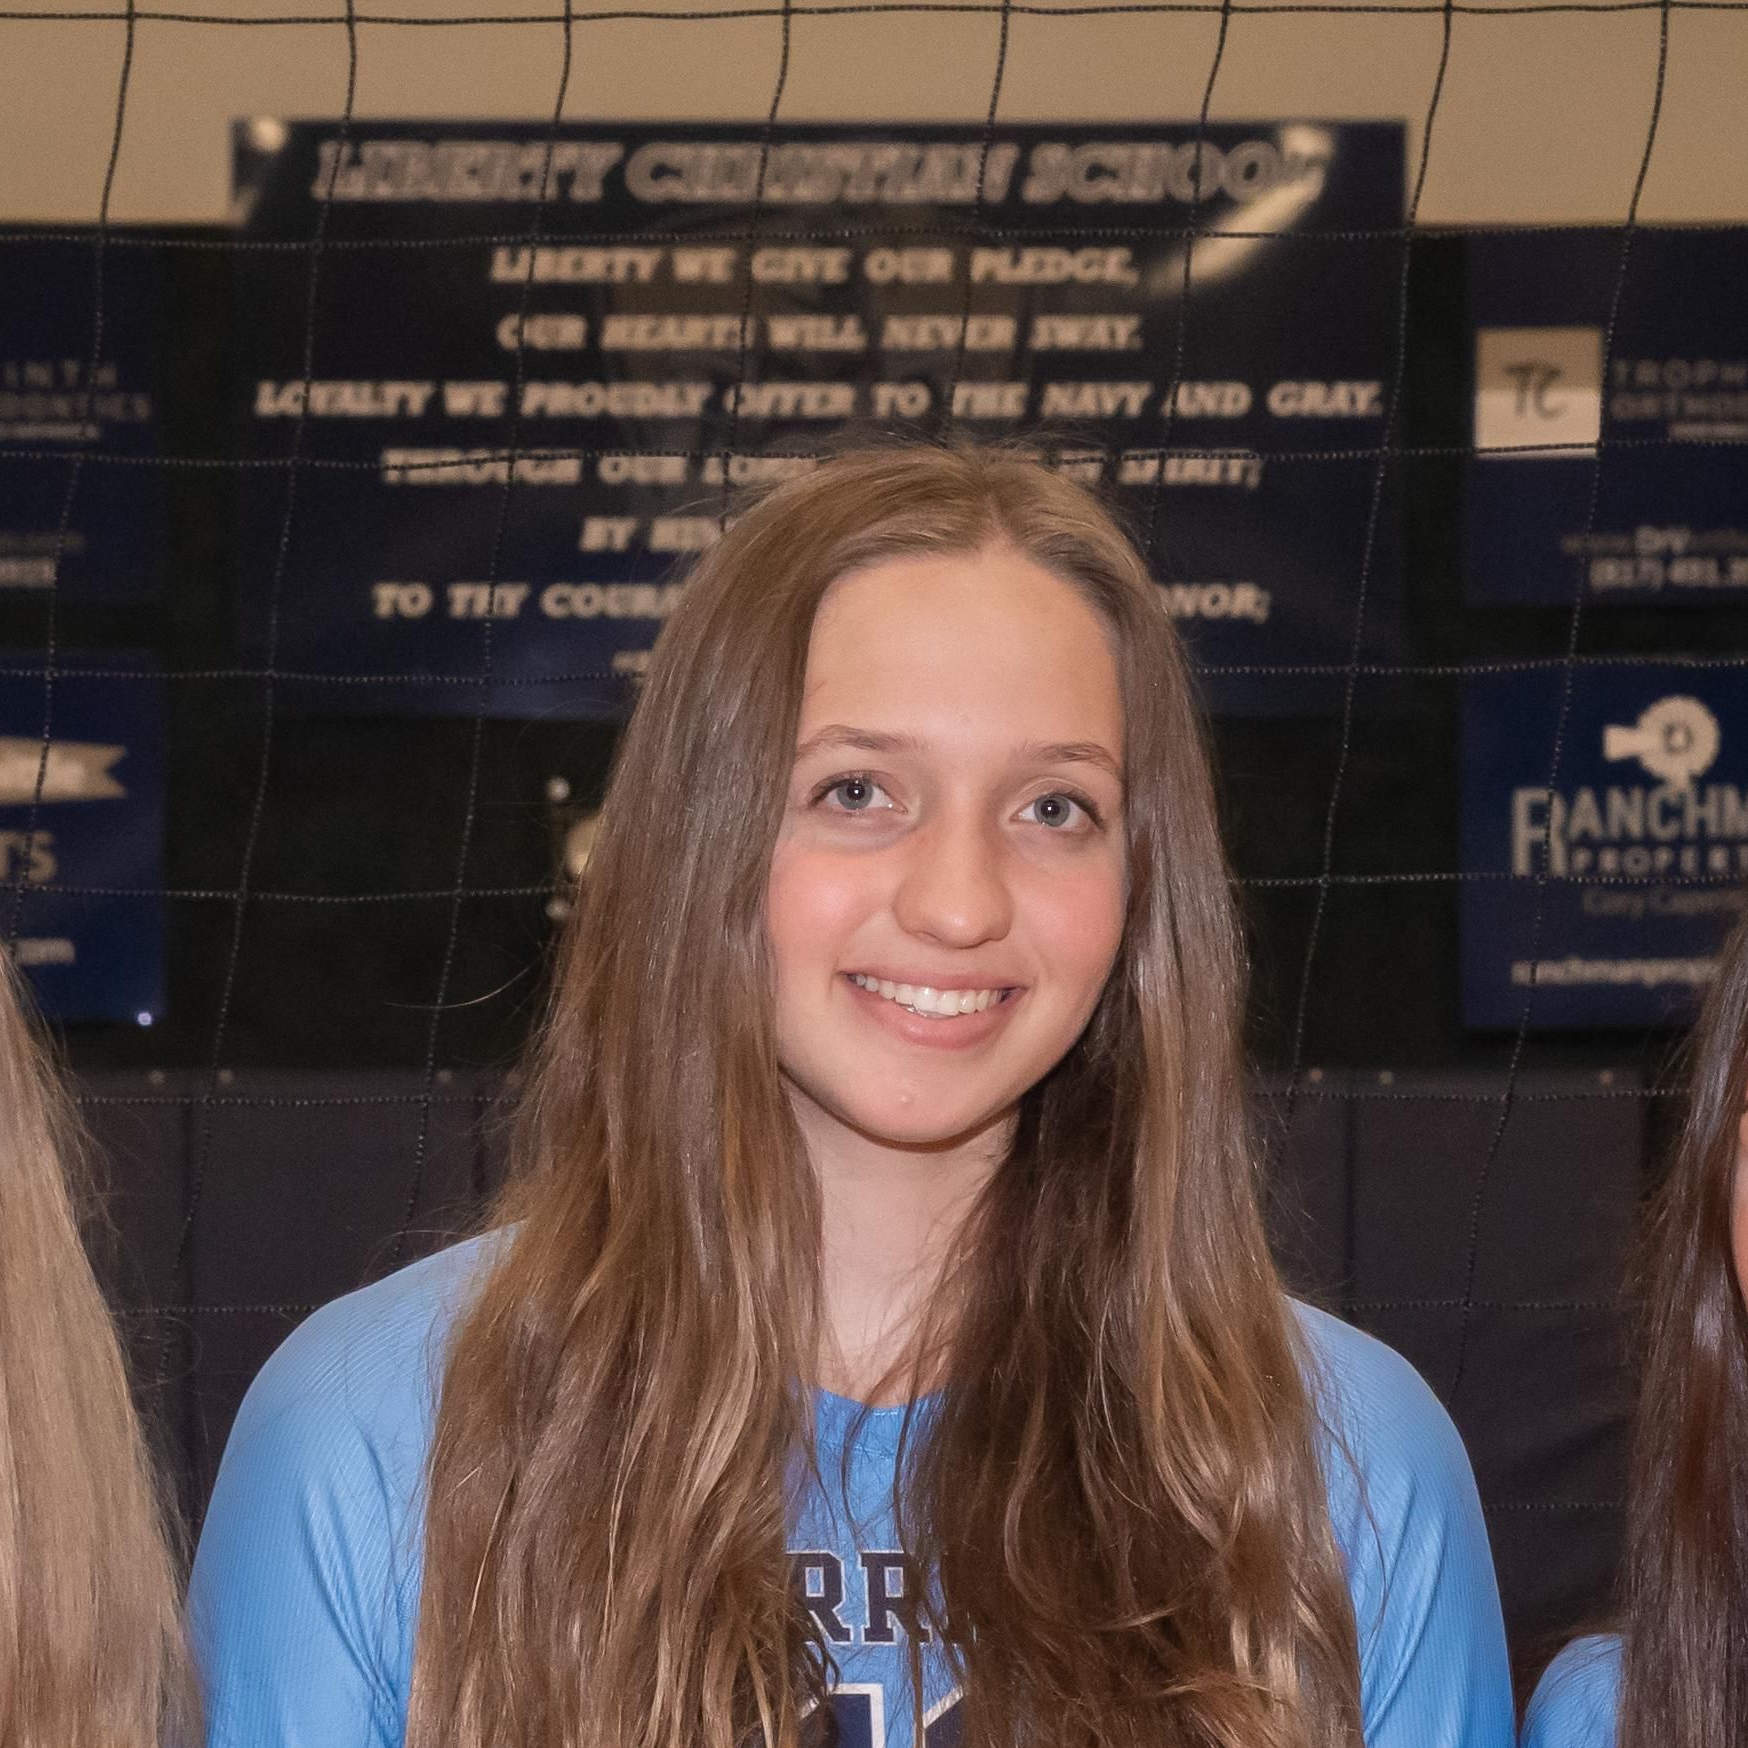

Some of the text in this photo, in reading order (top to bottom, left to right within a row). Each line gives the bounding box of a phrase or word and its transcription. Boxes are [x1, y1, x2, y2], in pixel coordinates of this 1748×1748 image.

[313, 141, 624, 201] LIBERTY
[489, 247, 661, 284] LIBERTY
[670, 247, 736, 284] WE
[752, 247, 851, 284] GIVE
[863, 247, 953, 284] OUR
[496, 314, 587, 350] OUR
[443, 380, 508, 418] WE
[870, 380, 932, 418] TO
[953, 380, 1029, 418] THE
[1041, 380, 1153, 418] NAVY
[371, 582, 433, 619] TO
